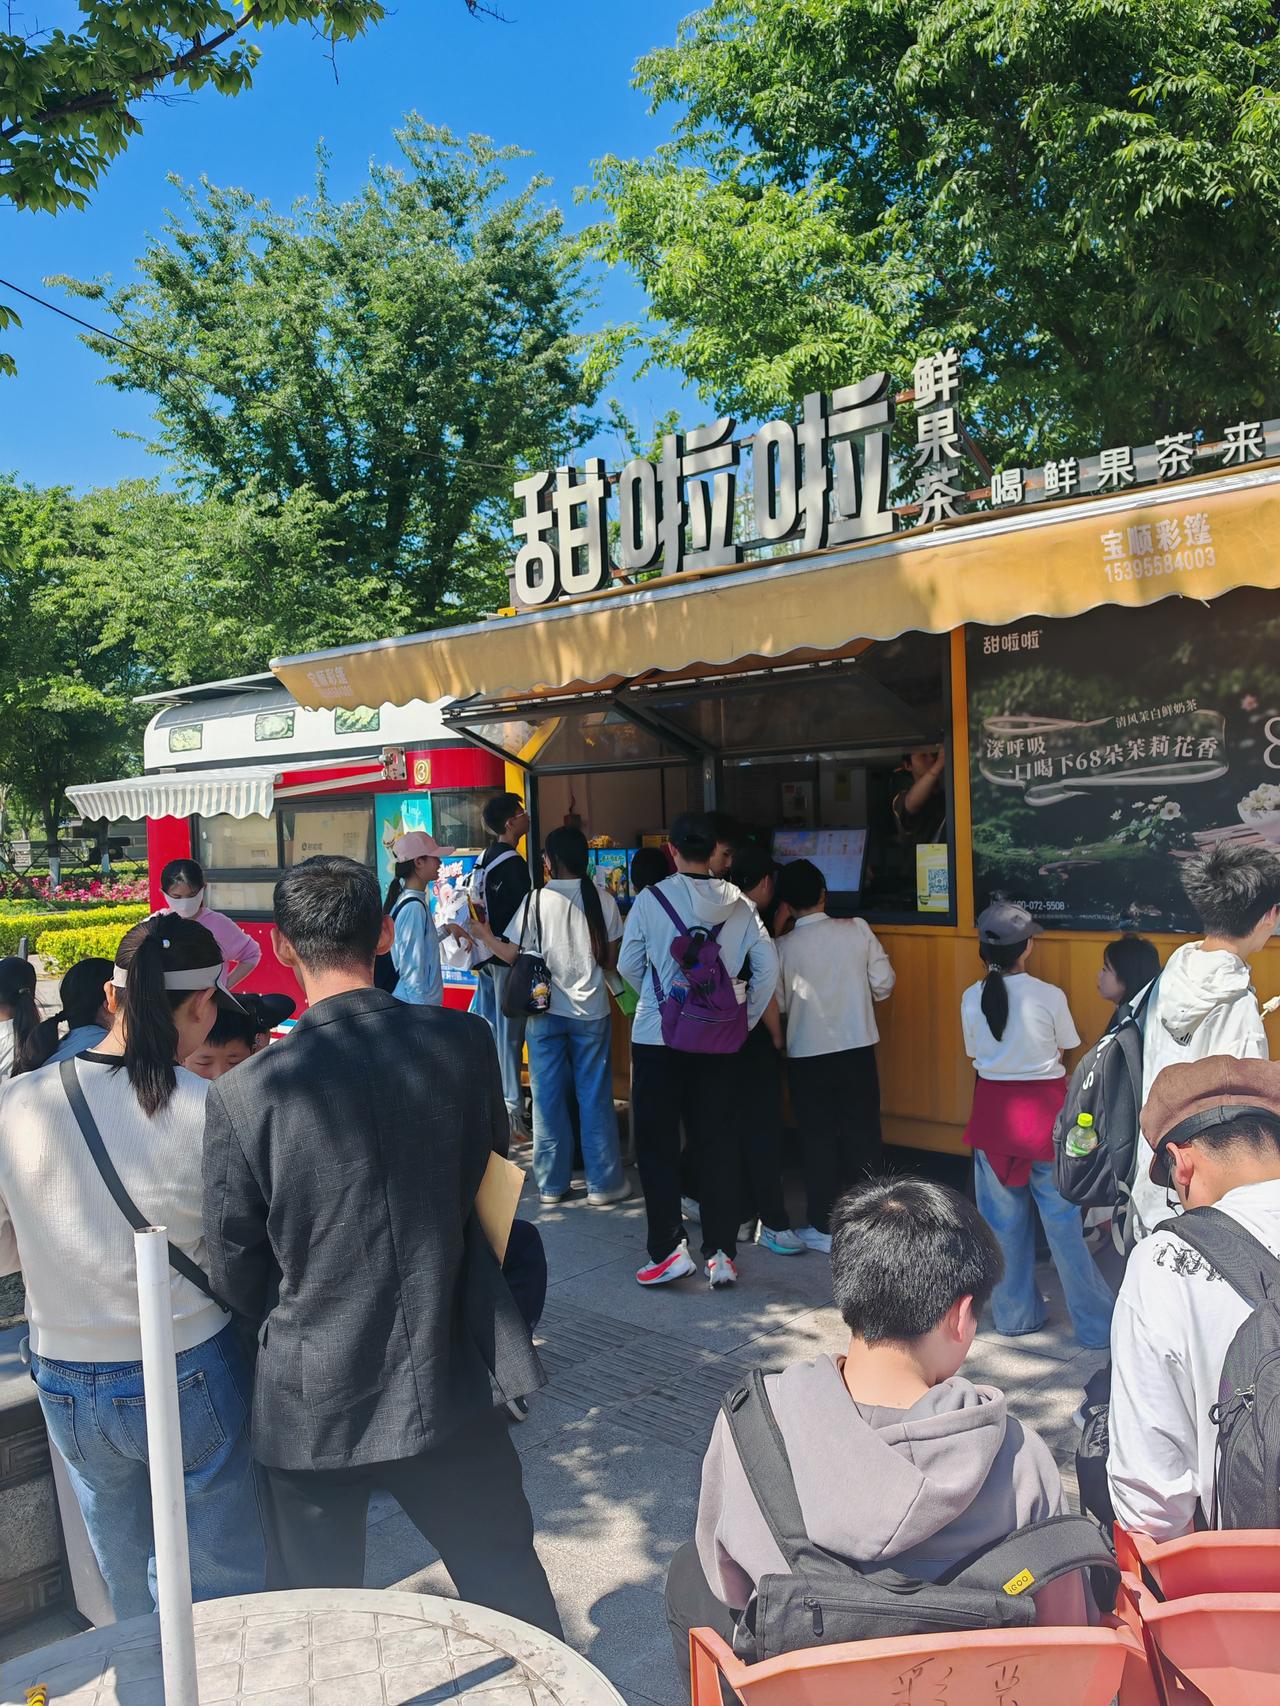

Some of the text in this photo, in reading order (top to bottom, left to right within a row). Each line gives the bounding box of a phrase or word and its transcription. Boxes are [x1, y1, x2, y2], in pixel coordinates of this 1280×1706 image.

[911, 347, 966, 526] 鲜果茶
[991, 421, 1264, 505] 喝鲜果茶来
[513, 372, 896, 604] 甜啦啦
[1104, 547, 1217, 584] 15395584003
[983, 630, 1040, 655] 甜啦啦
[985, 737, 1048, 759] 深呼吸
[993, 735, 1219, 782] 一口喝下68朵茉莉花香
